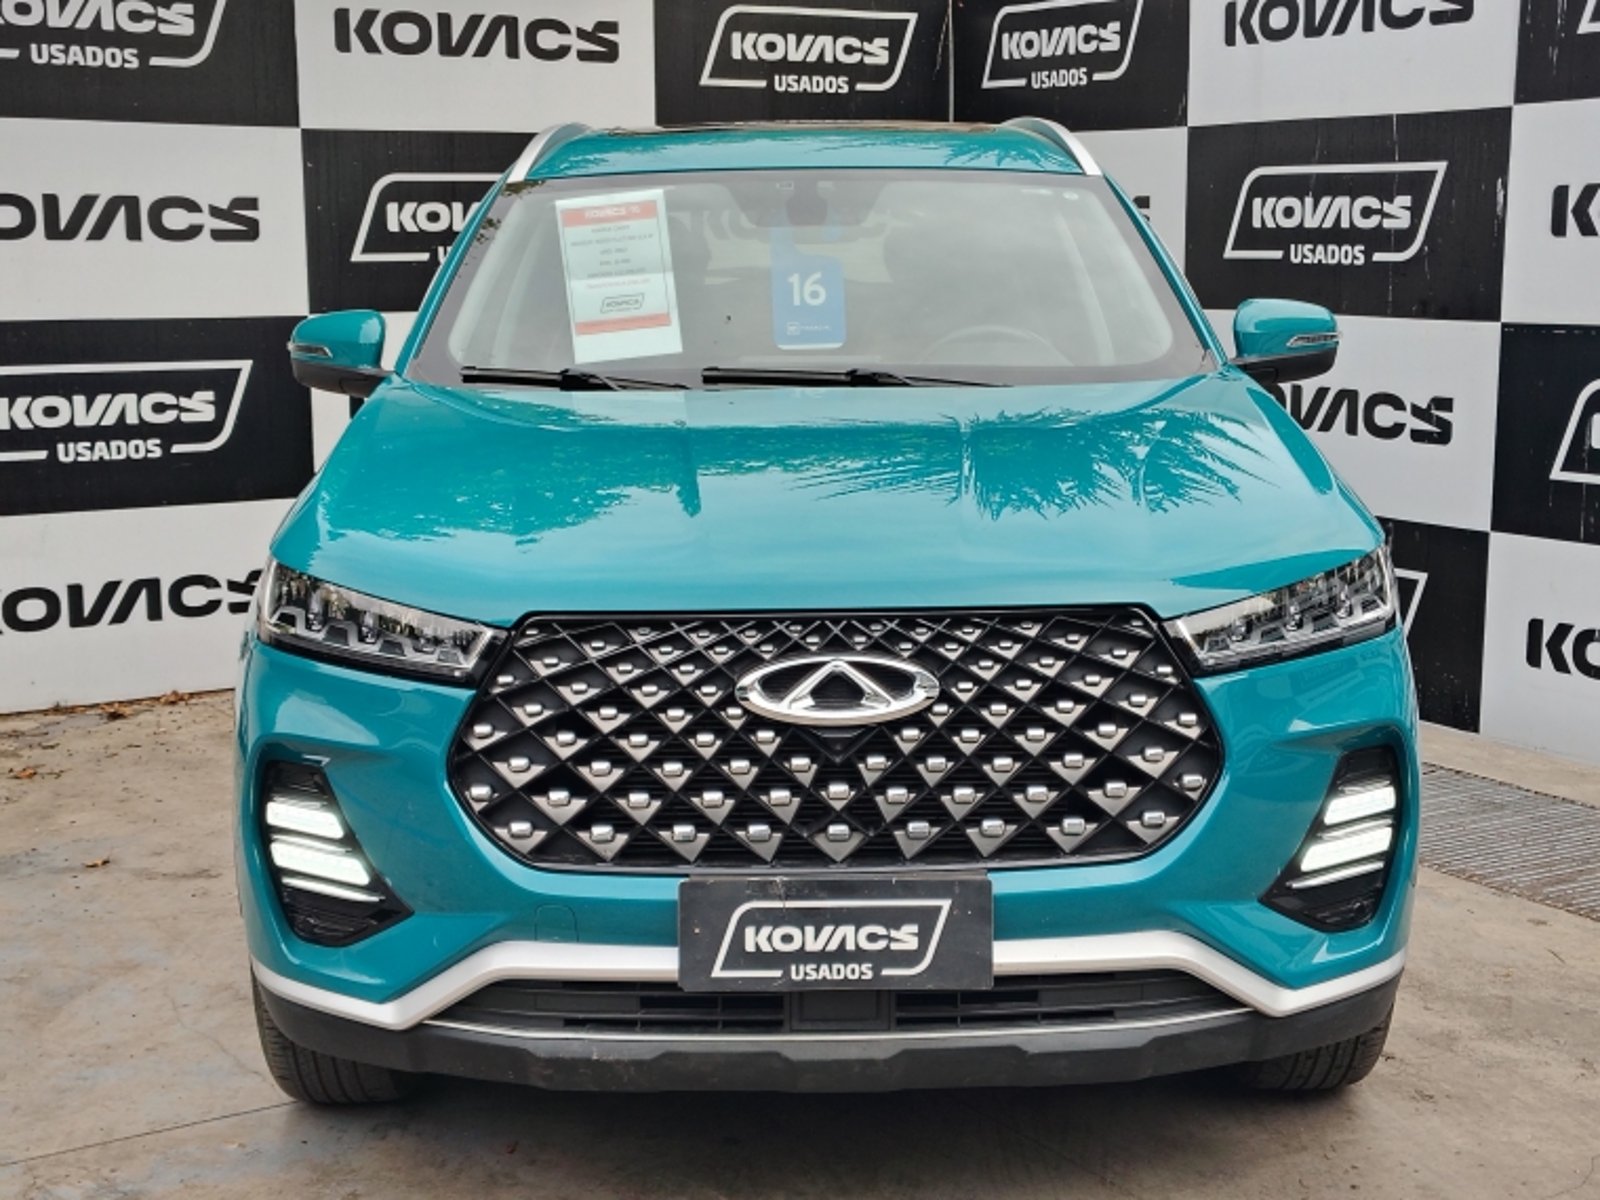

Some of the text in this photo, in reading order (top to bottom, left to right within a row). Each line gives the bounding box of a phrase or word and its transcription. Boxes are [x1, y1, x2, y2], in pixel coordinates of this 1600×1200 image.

[0, 0, 195, 36] OVACS
[334, 8, 620, 63] KOVACS
[731, 31, 890, 65] KOVACS
[1001, 21, 1121, 60] KOVACS
[30, 43, 139, 69] USADOS
[774, 75, 849, 94] USADOS
[1031, 67, 1087, 90] USADOS
[0, 193, 259, 242] OVACS
[1252, 195, 1412, 229] KOVACS
[1289, 243, 1365, 266] USADOS
[787, 271, 827, 306] 16
[0, 391, 216, 430] KOVACS
[57, 439, 162, 463] USADOS
[744, 924, 919, 952] KOVACS
[791, 963, 873, 981] USADOS
